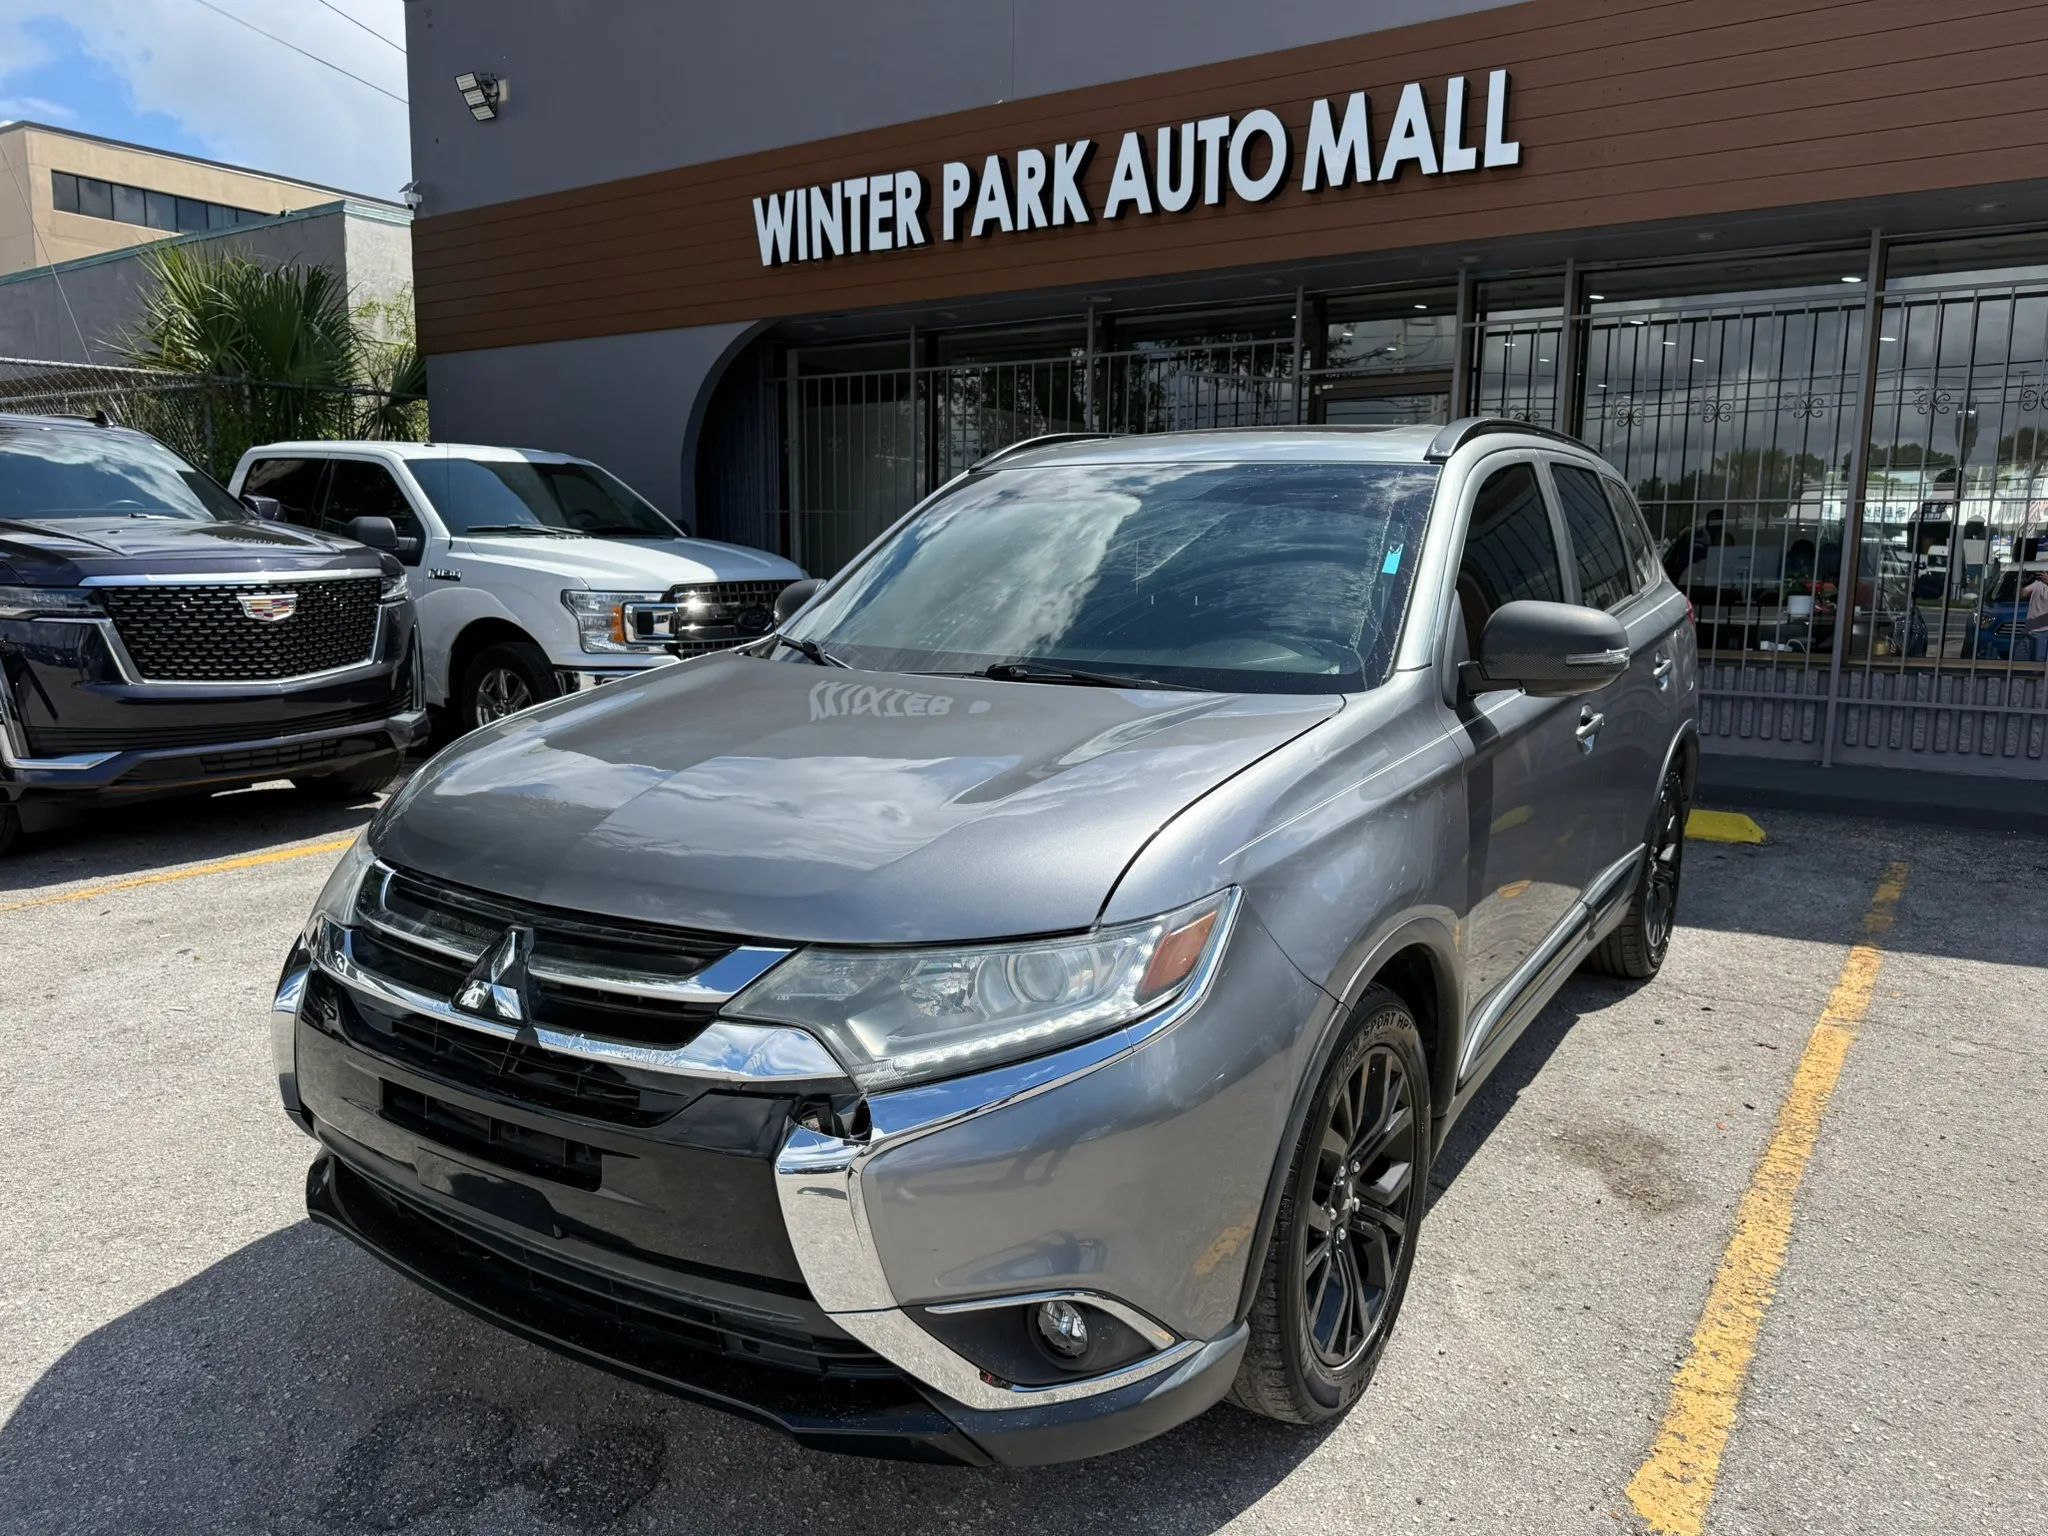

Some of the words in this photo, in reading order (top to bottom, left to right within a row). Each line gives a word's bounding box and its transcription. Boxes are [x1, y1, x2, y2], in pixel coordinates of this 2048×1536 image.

[752, 170, 926, 268] WINTER
[943, 139, 1091, 241] PARK
[1103, 109, 1288, 219] AUTO
[1301, 69, 1521, 191] MALL
[1363, 1011, 1397, 1041] SPORT
